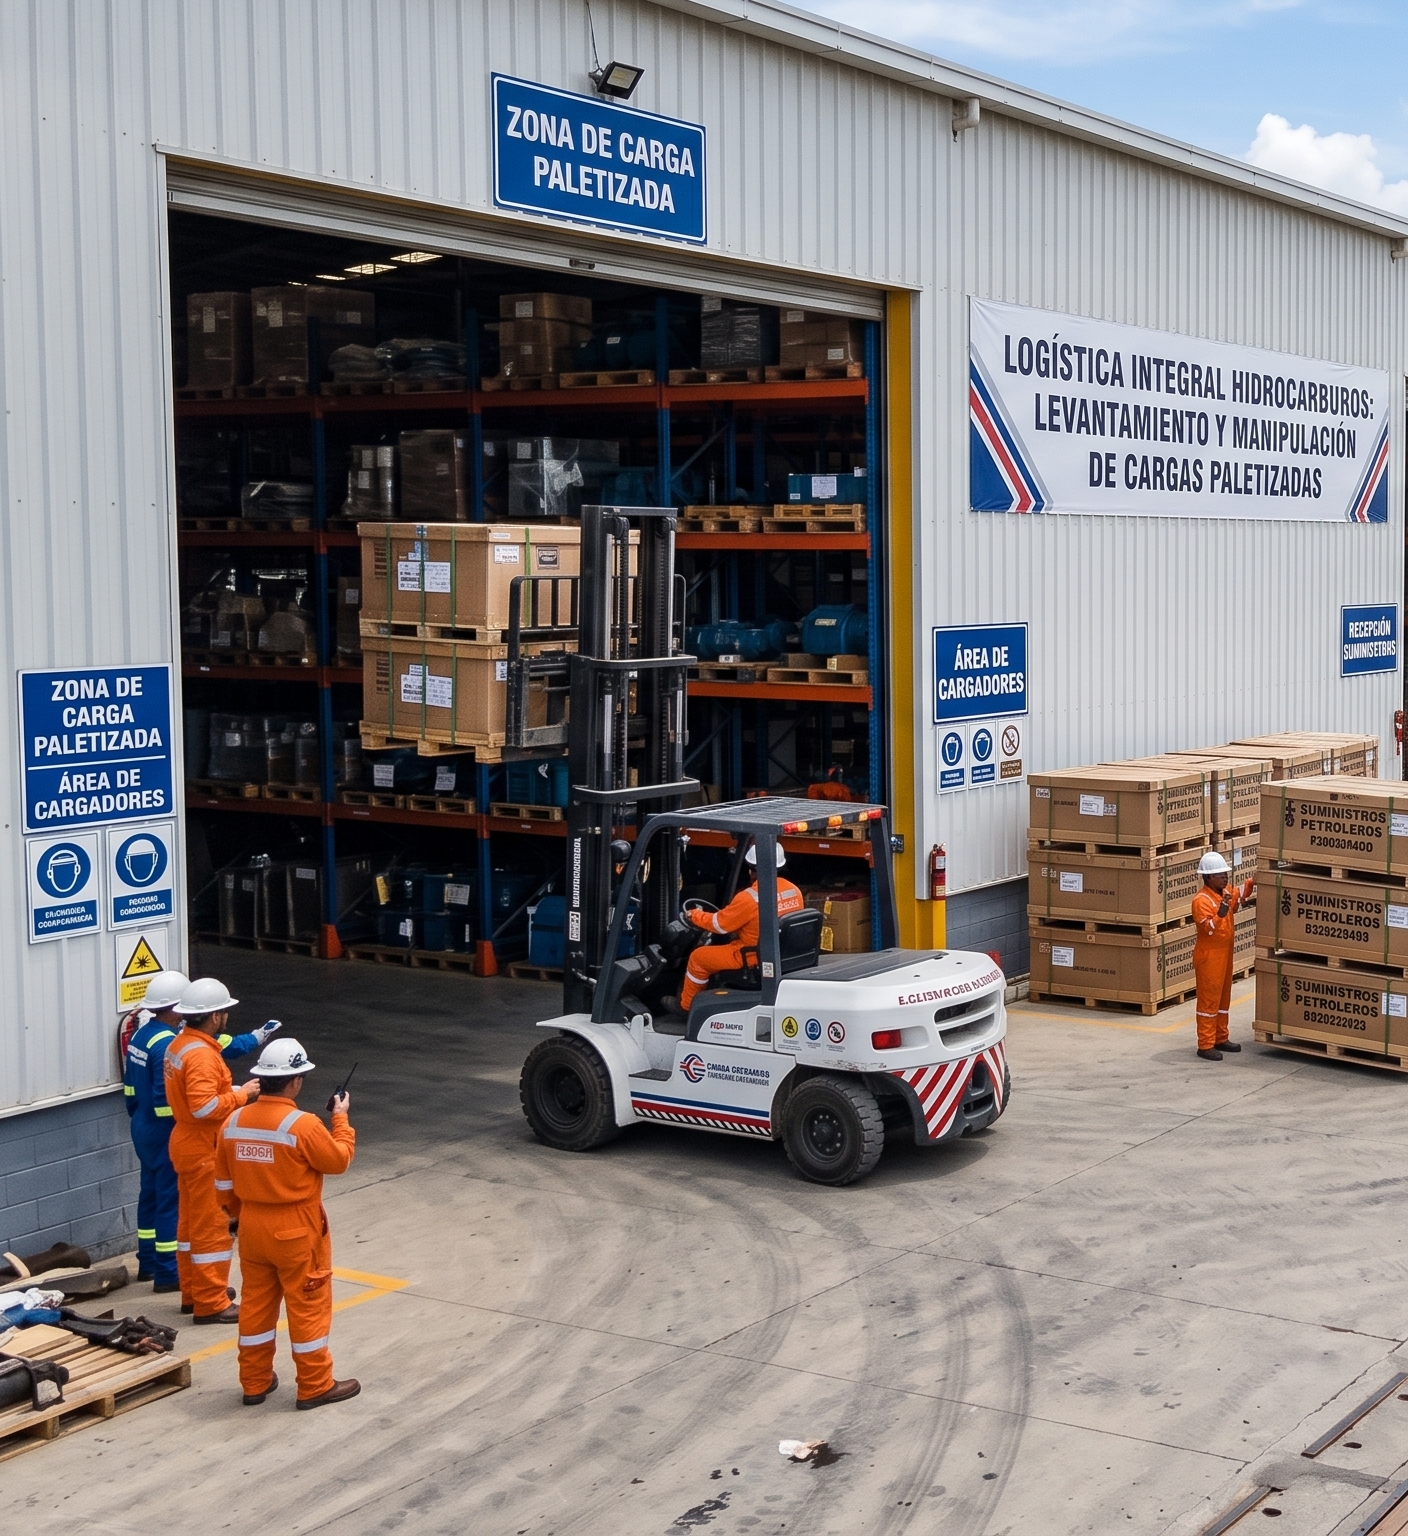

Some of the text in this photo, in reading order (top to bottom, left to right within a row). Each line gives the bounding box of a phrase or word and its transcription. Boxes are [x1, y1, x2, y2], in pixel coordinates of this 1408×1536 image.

[506, 104, 695, 178] ZONA DE CARGA
[533, 155, 676, 214] PALETIZADA
[1003, 332, 1375, 420] LOGÍSTICA INTEGRAL HIDROCARBUROS:
[1033, 392, 1356, 459] LEVANTAMIENTO Y MANIPULACIÓN
[1088, 451, 1323, 499] DE CARGAS PALETIZADAS
[954, 643, 1009, 671] ÁREA DE
[51, 675, 143, 702] ZONA DE
[938, 671, 1024, 700] CARGADORES
[62, 703, 135, 728] CARGA
[34, 727, 163, 757] PALETIZADA
[58, 767, 141, 795] ÁREA DE
[34, 788, 165, 821] CARGADORES
[1300, 804, 1387, 824] SUMINISTROS
[1300, 819, 1383, 838] PETROLEROS
[1296, 893, 1382, 915] SUMINISTROS
[1297, 907, 1380, 929] PETROLEROS
[1294, 980, 1380, 1003] SUMINISTROS
[1295, 994, 1379, 1018] PETROLEROS
